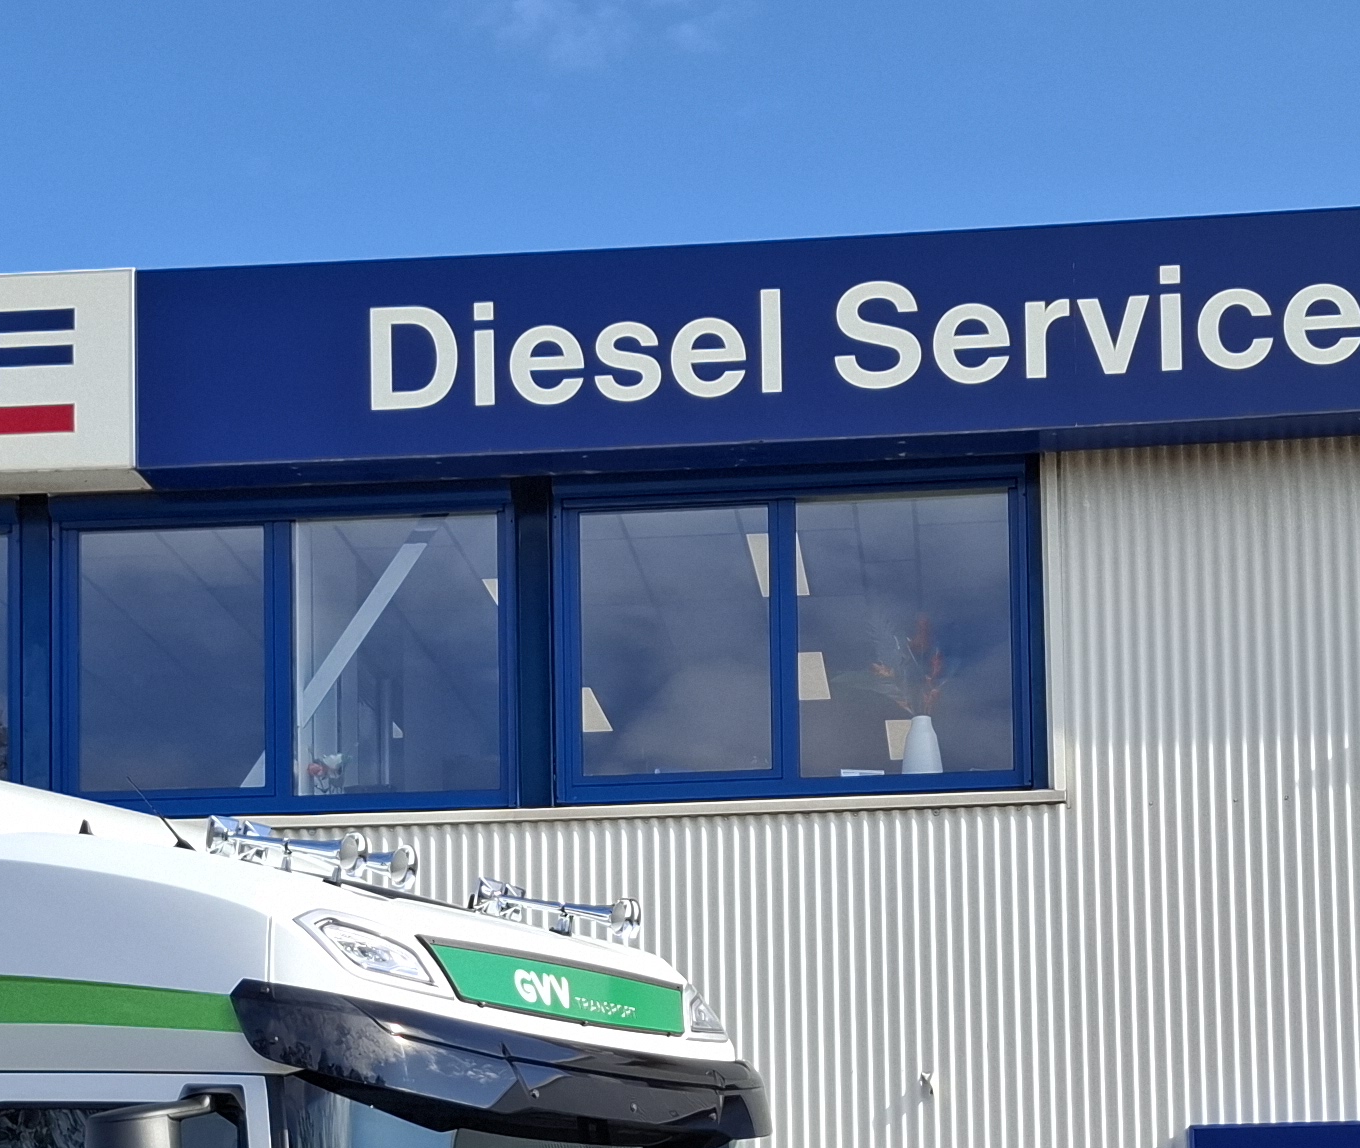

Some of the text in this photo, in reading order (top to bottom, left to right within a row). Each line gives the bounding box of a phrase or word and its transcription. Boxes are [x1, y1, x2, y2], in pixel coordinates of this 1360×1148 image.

[369, 288, 782, 411] Diesel
[514, 968, 637, 1019] GVV TRANSPORT
